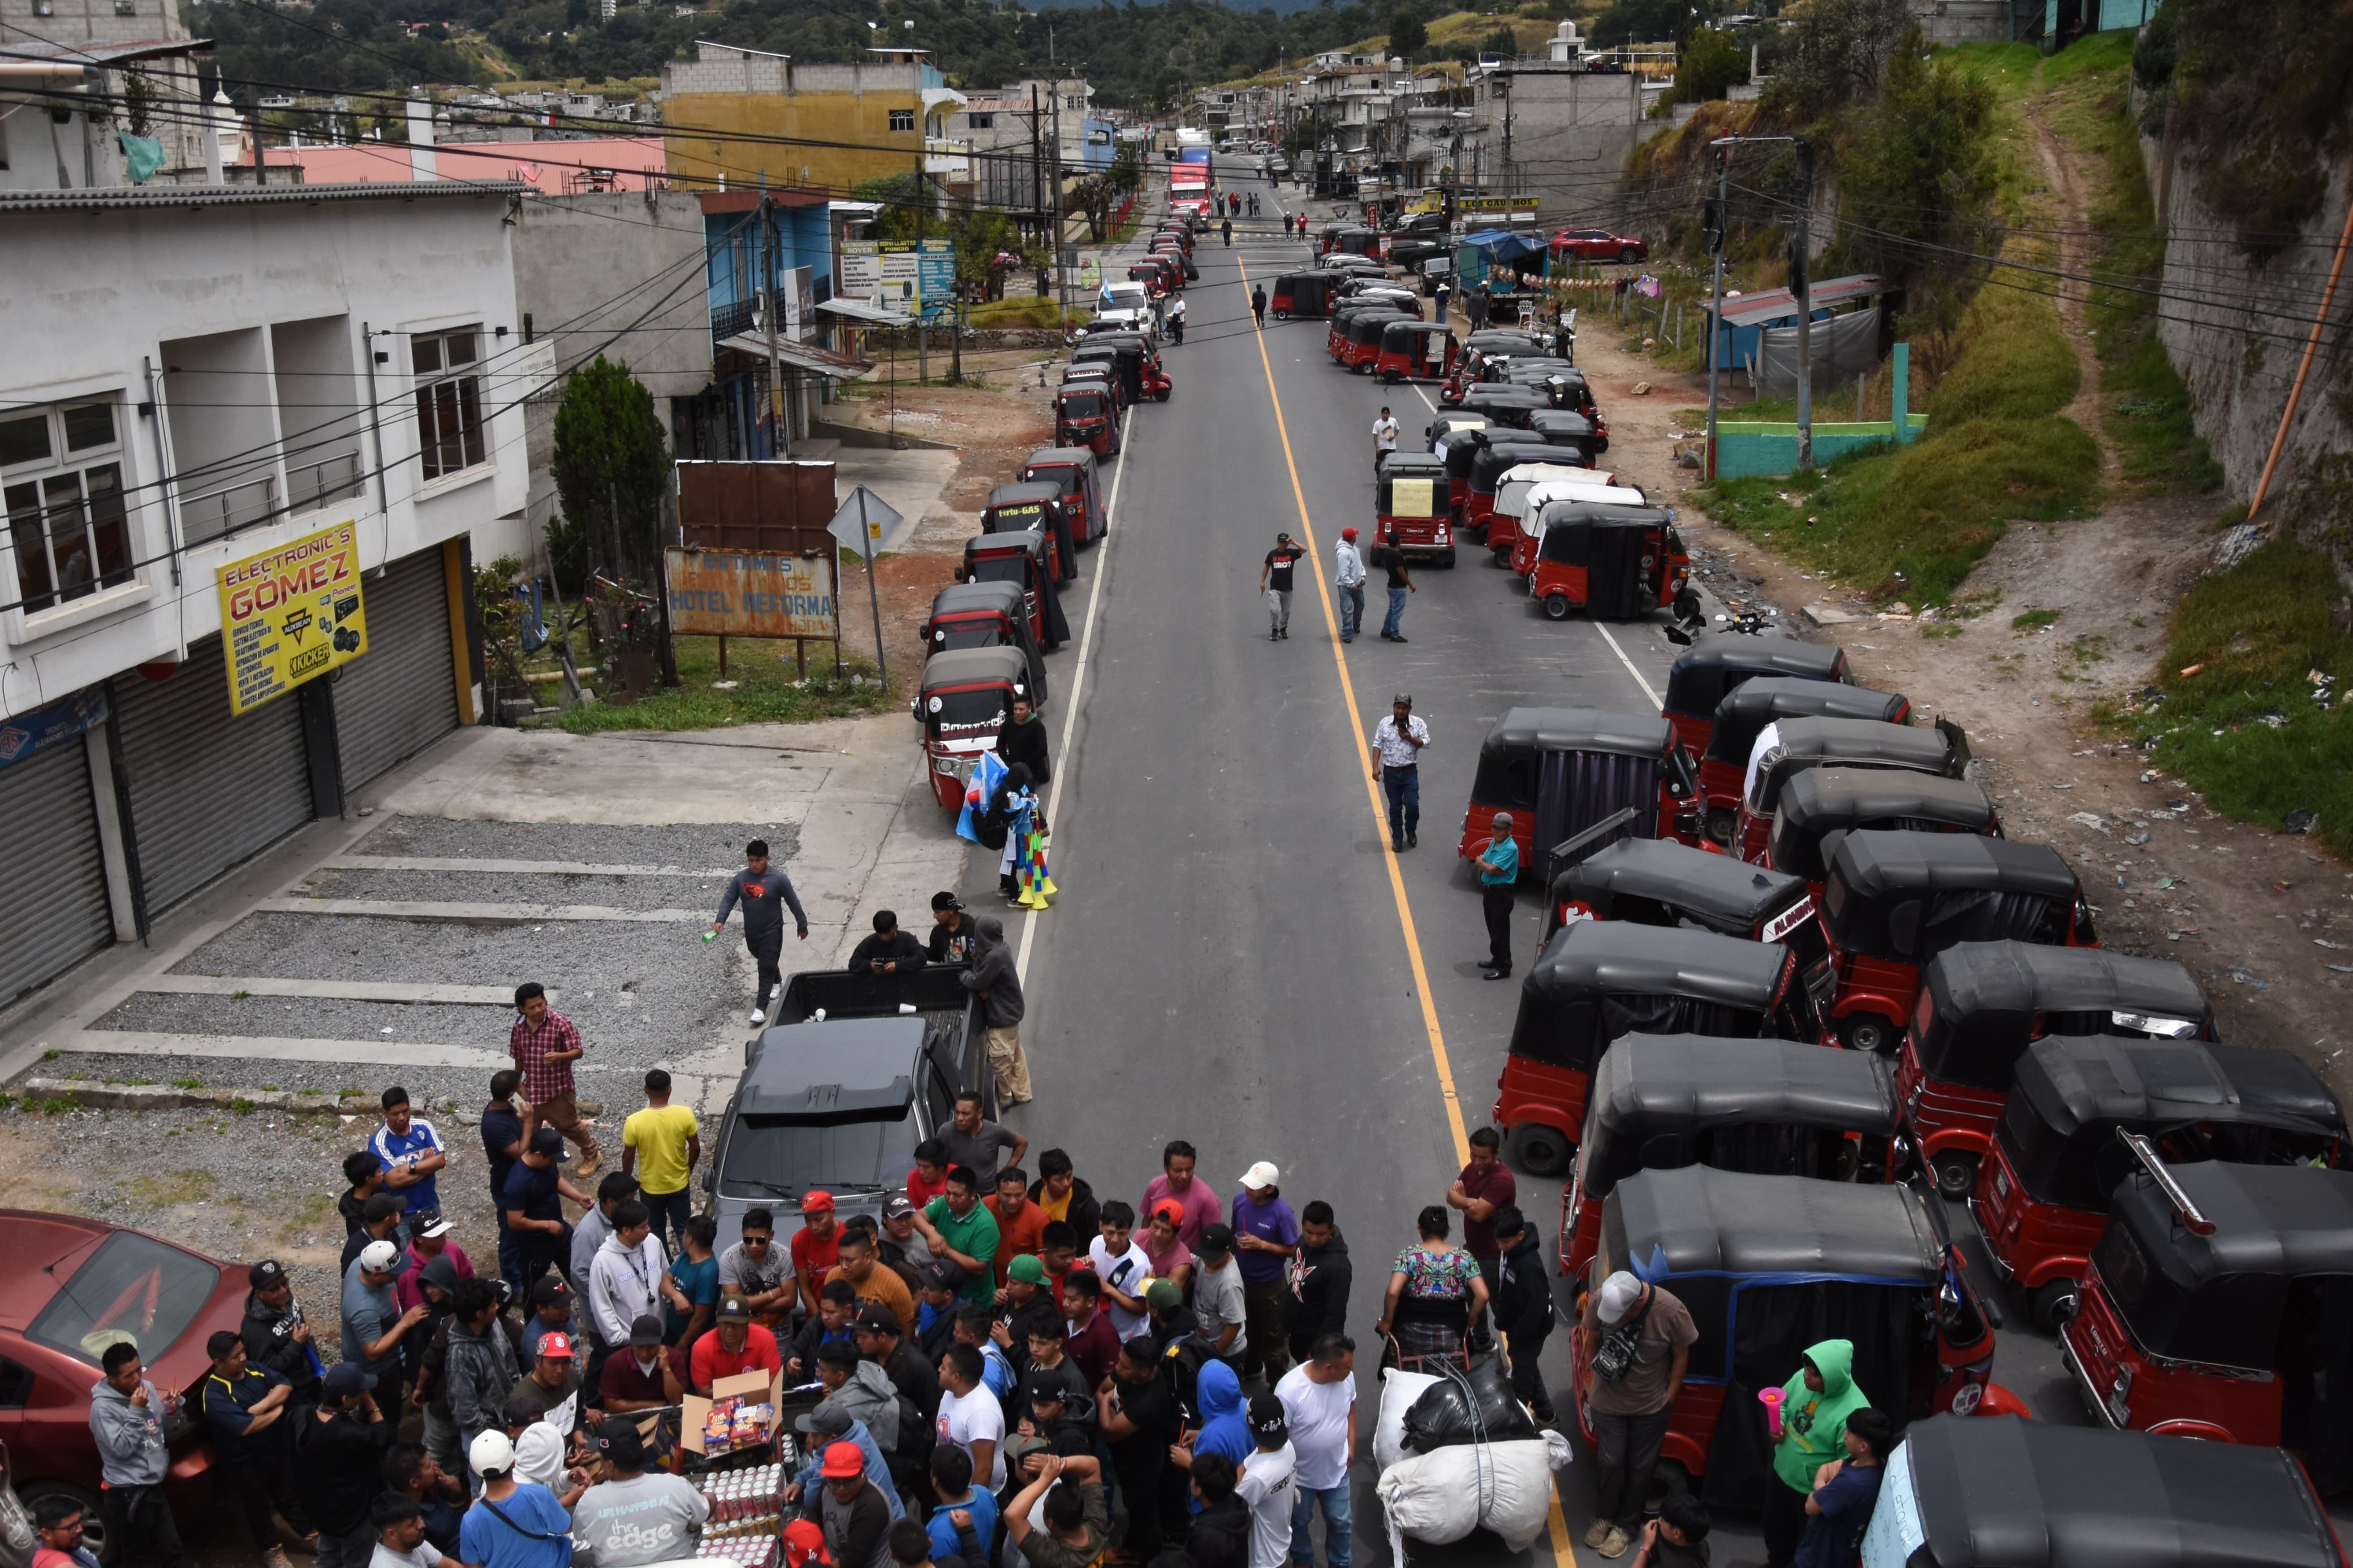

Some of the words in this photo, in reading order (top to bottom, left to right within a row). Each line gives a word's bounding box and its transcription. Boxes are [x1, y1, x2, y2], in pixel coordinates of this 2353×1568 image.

[1487, 198, 1532, 207] GAUHOS
[704, 554, 792, 572] ESTAMOS
[230, 550, 350, 621] GÓMEZ
[333, 583, 357, 597] Pioneer
[672, 590, 733, 613] HOTEL
[744, 592, 832, 616] REFORMA
[267, 625, 272, 633] DE
[284, 617, 311, 634] AUXBEAM
[235, 649, 240, 658] SU
[257, 650, 262, 658] DE
[262, 642, 279, 656] APARATOS
[240, 689, 244, 698] DE
[245, 684, 257, 696] RADIOS
[258, 676, 273, 690] BOCINAS
[241, 694, 257, 708] WOOFERS
[615, 1498, 658, 1515] HAPPENS
[658, 1495, 670, 1506] AT
[611, 1519, 634, 1535] the
[606, 1524, 673, 1549] edge
